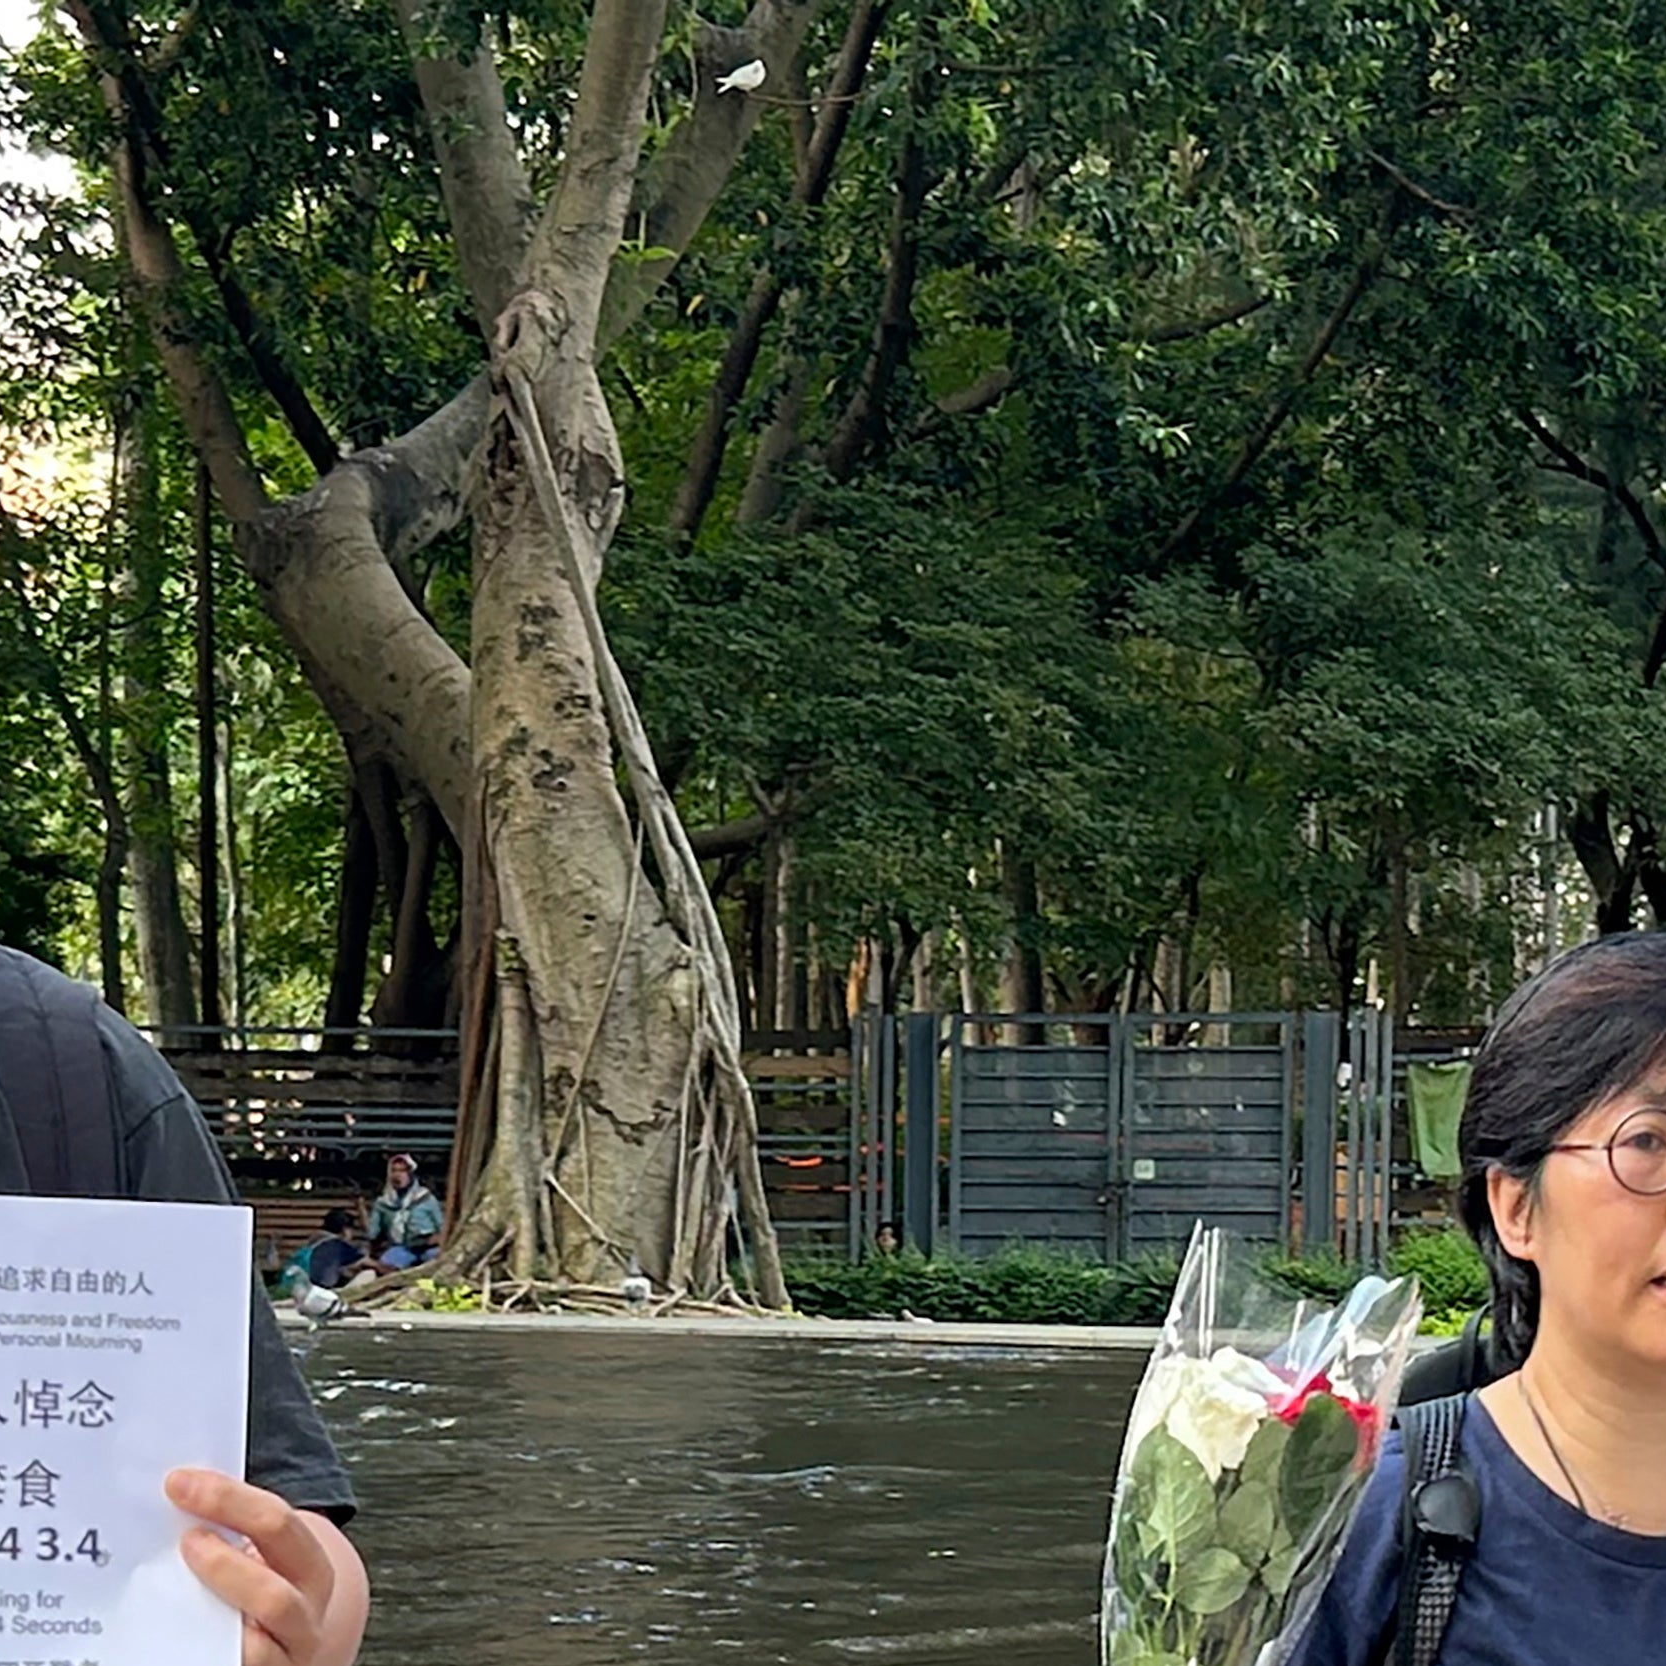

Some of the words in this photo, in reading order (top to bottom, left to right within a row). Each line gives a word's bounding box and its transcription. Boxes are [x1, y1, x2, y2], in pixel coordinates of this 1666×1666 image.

[72, 1312, 101, 1328] and
[106, 1314, 181, 1331] Freedom
[66, 1334, 143, 1353] Mourning
[37, 1590, 64, 1609] for
[12, 1615, 102, 1635] Seconds
